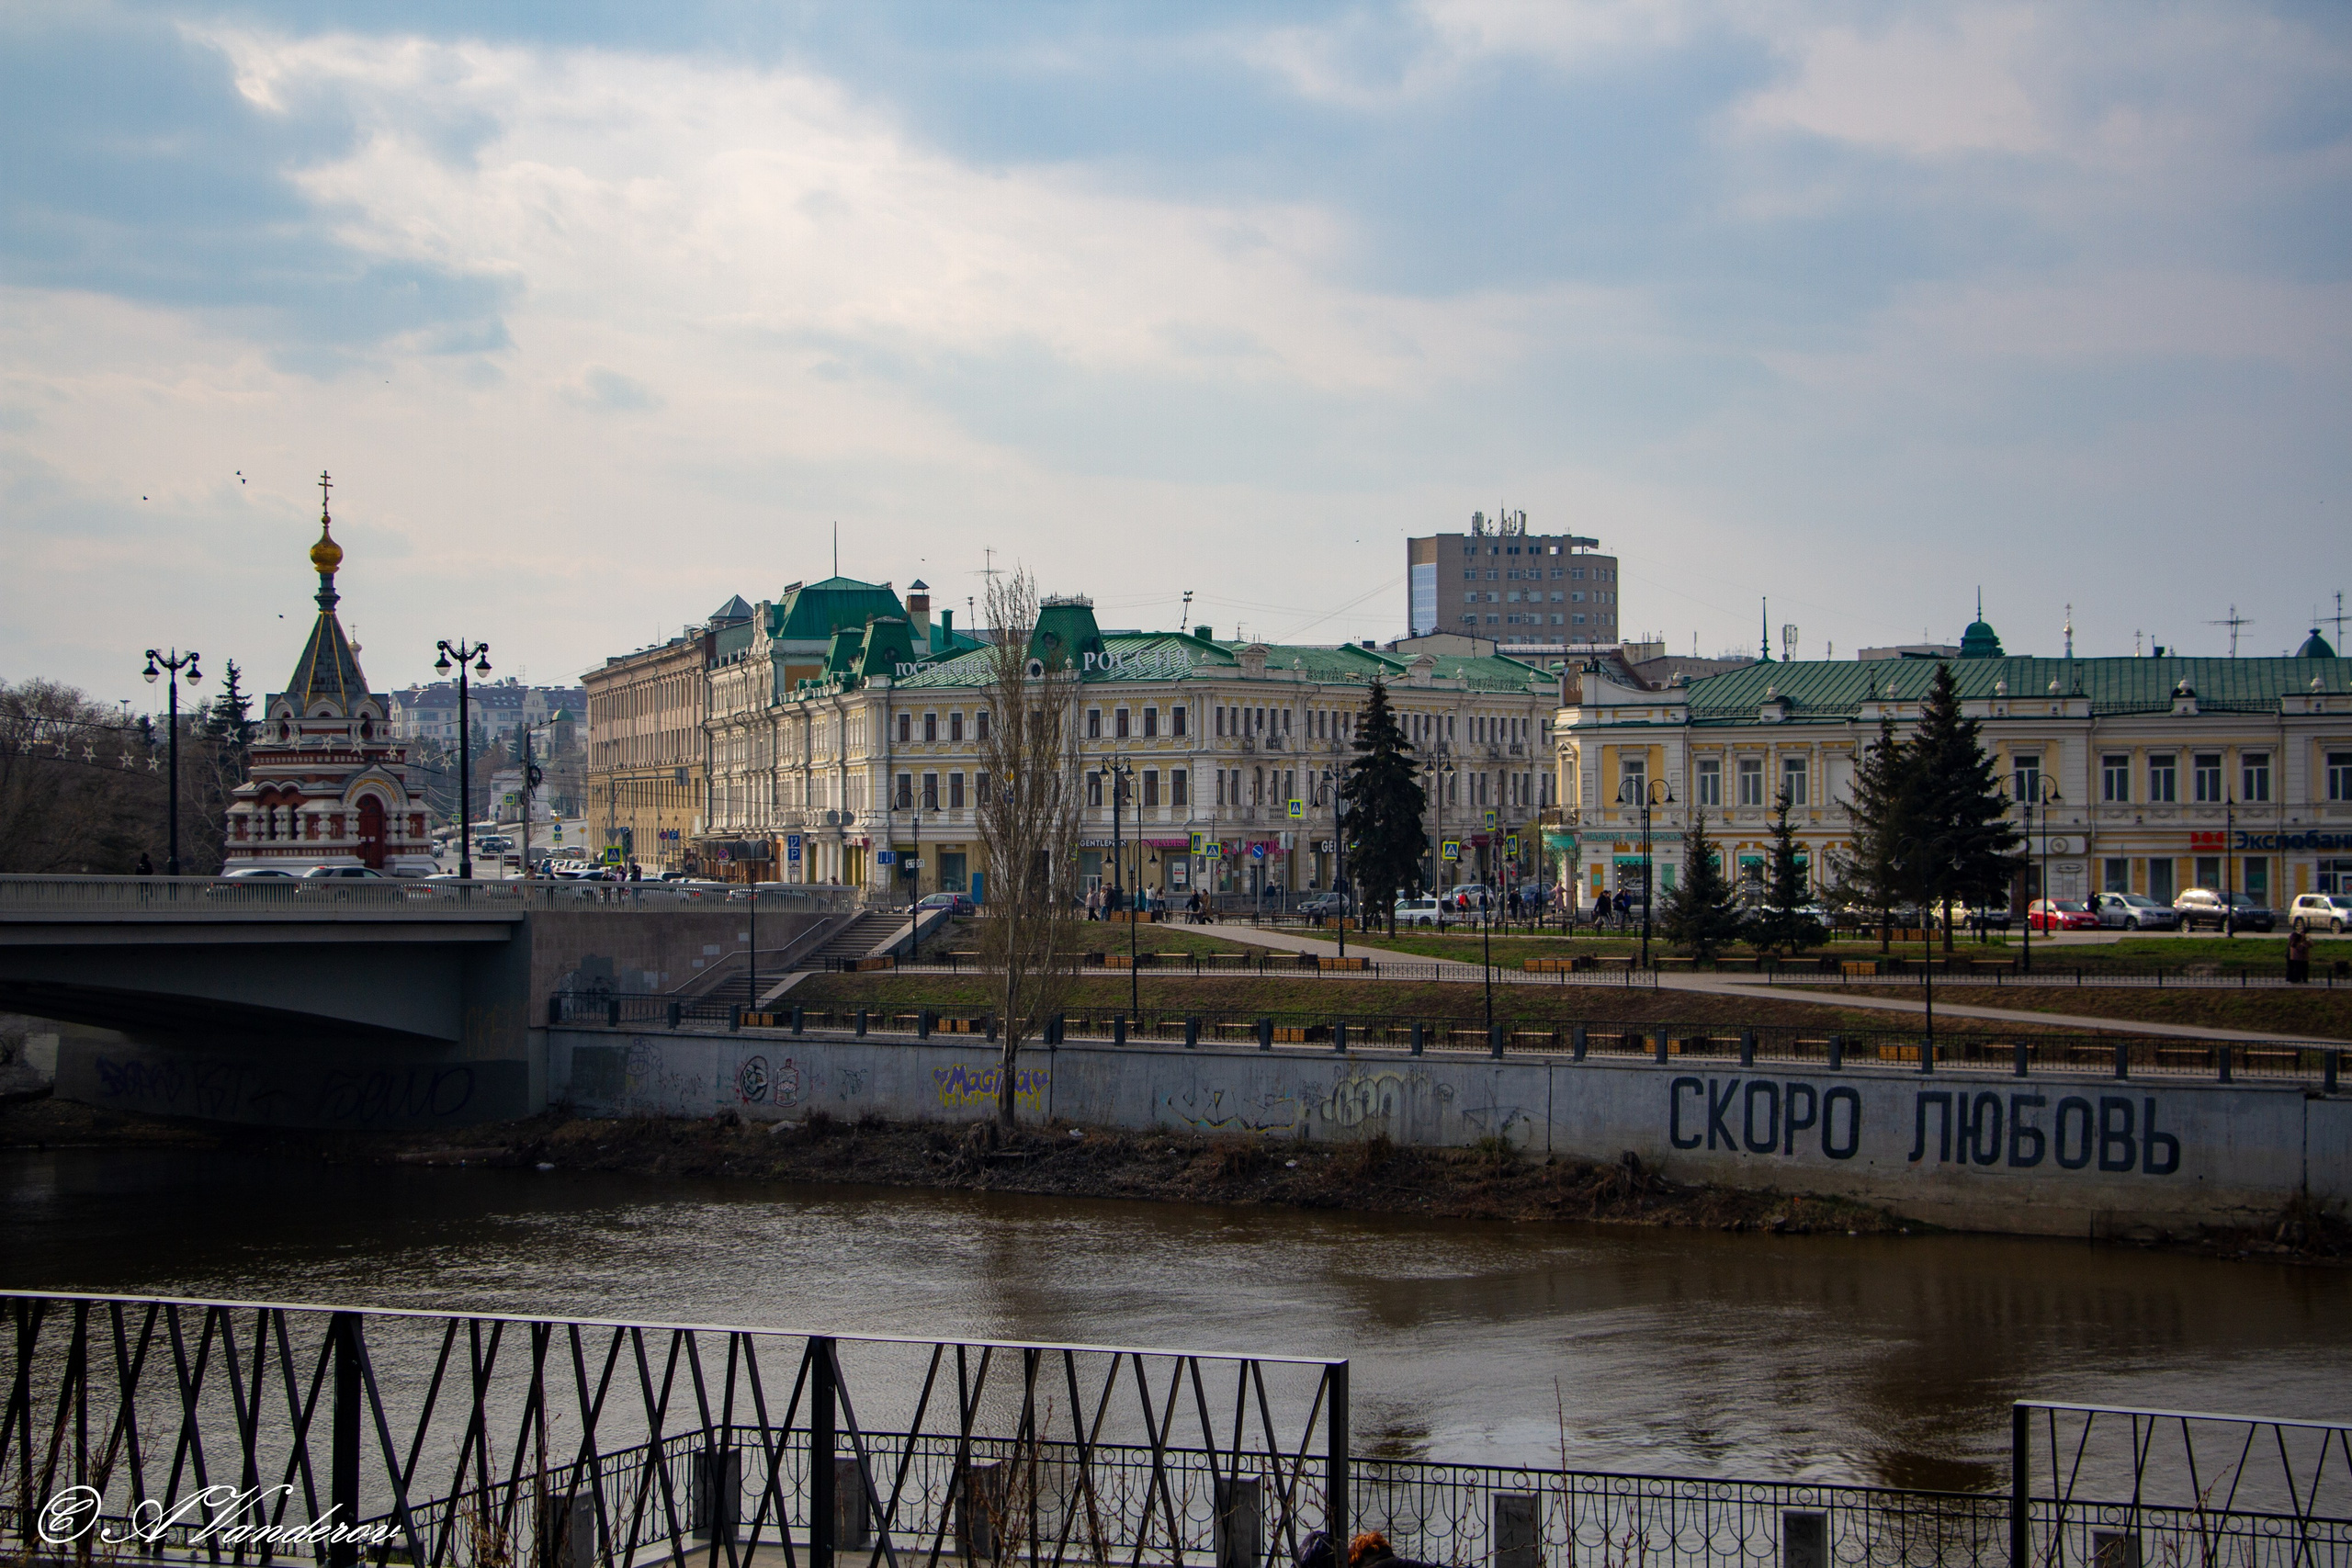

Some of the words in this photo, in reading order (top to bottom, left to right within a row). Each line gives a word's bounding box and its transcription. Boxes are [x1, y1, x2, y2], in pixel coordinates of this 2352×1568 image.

[895, 660, 993, 677] ГОСТИНИЦА
[1083, 648, 1189, 671] РОССИЯ
[2234, 829, 2352, 850] Экспобан
[1669, 1077, 1860, 1160] СКОРО
[1907, 1090, 2181, 1175] ЛЮБОВЬ
